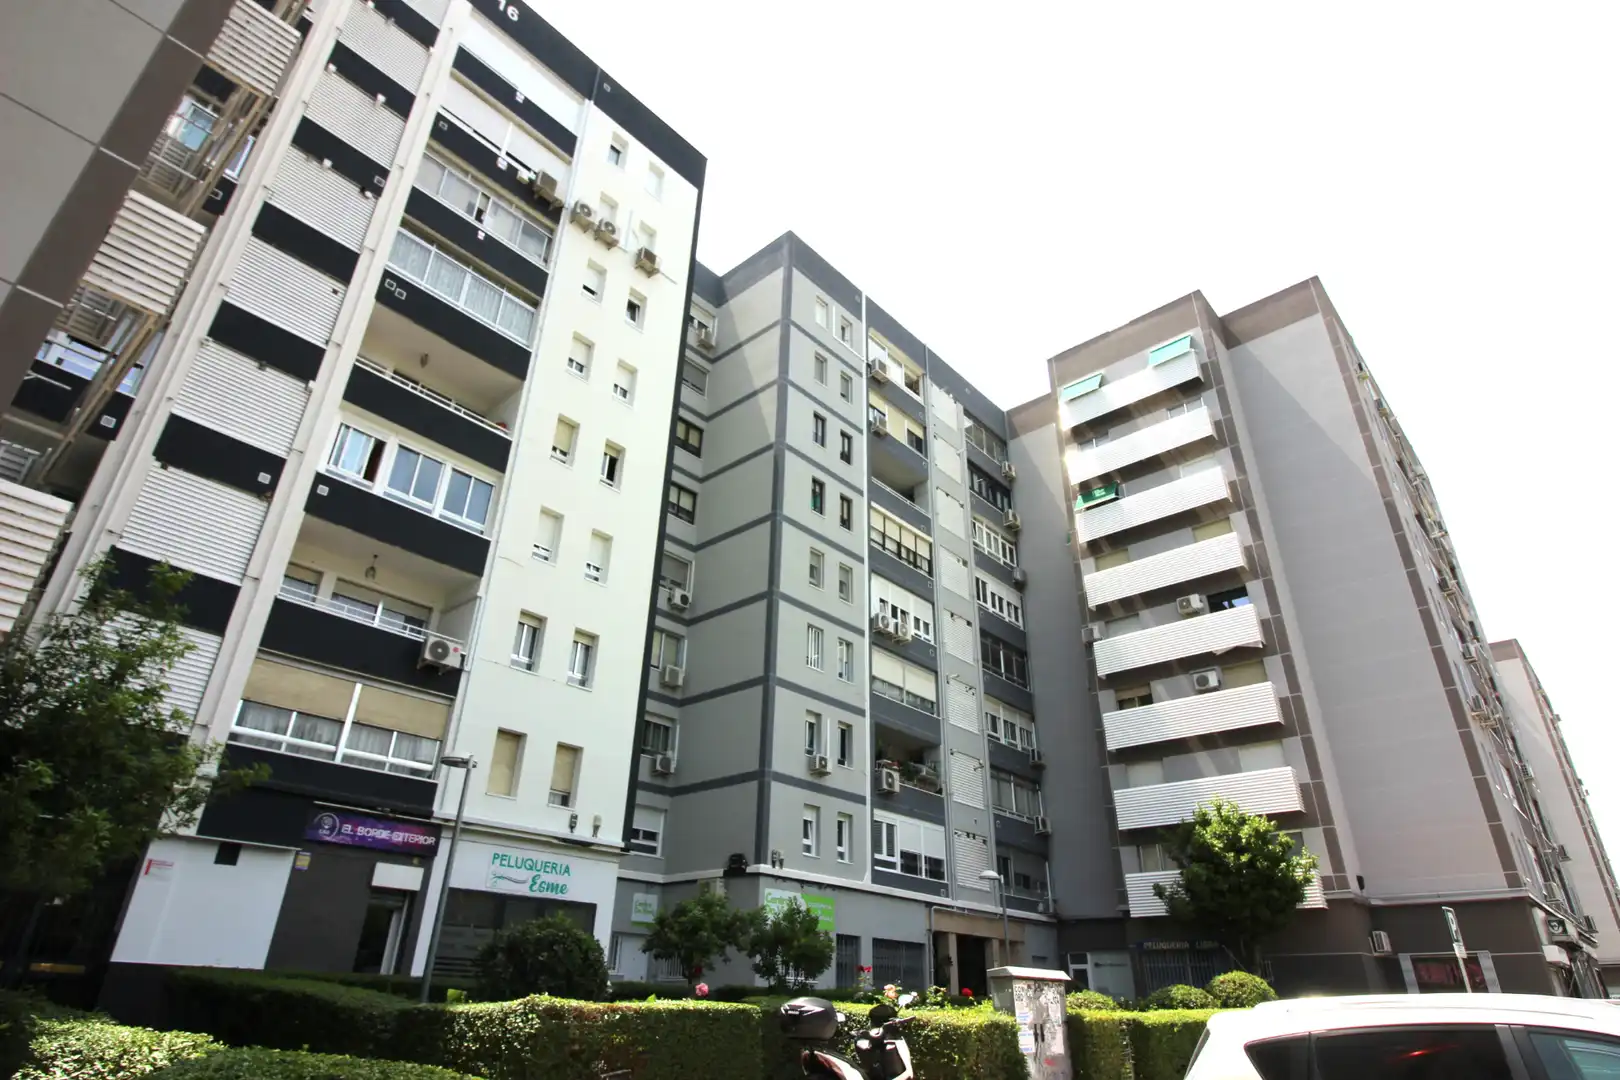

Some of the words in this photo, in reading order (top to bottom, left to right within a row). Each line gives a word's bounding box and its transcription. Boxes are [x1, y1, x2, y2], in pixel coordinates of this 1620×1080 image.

[498, 0, 520, 22] 16
[341, 823, 354, 835] EL
[491, 852, 571, 877] PELUQUERIA
[528, 873, 568, 895] Esme
[1446, 910, 1457, 940] P
